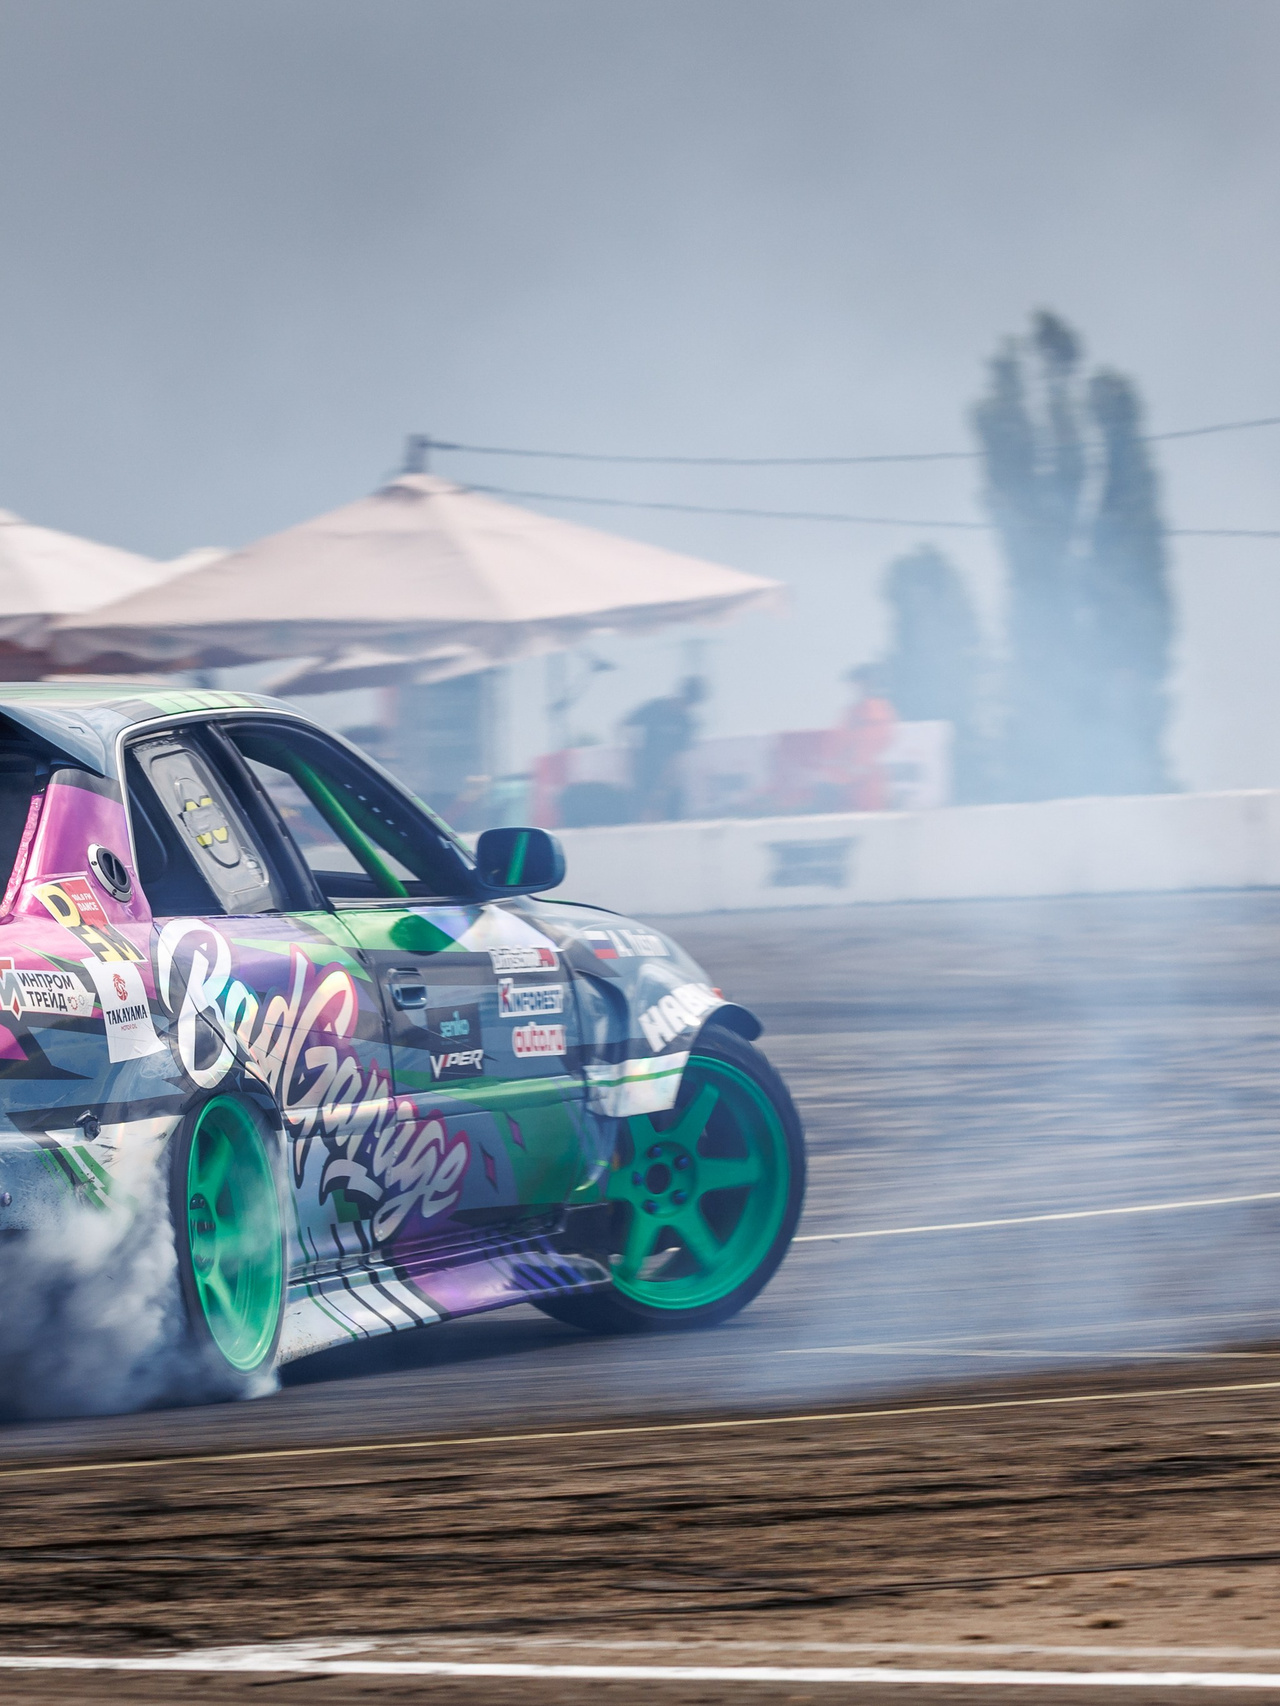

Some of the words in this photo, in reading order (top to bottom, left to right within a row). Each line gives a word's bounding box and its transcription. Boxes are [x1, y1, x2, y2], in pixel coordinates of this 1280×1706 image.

[77, 901, 99, 912] DANCE
[17, 972, 75, 990] ИНПРОМ
[26, 988, 68, 1012] ТРЕЙД
[106, 1004, 148, 1025] TAKAYAMA
[429, 1049, 484, 1079] VIPER
